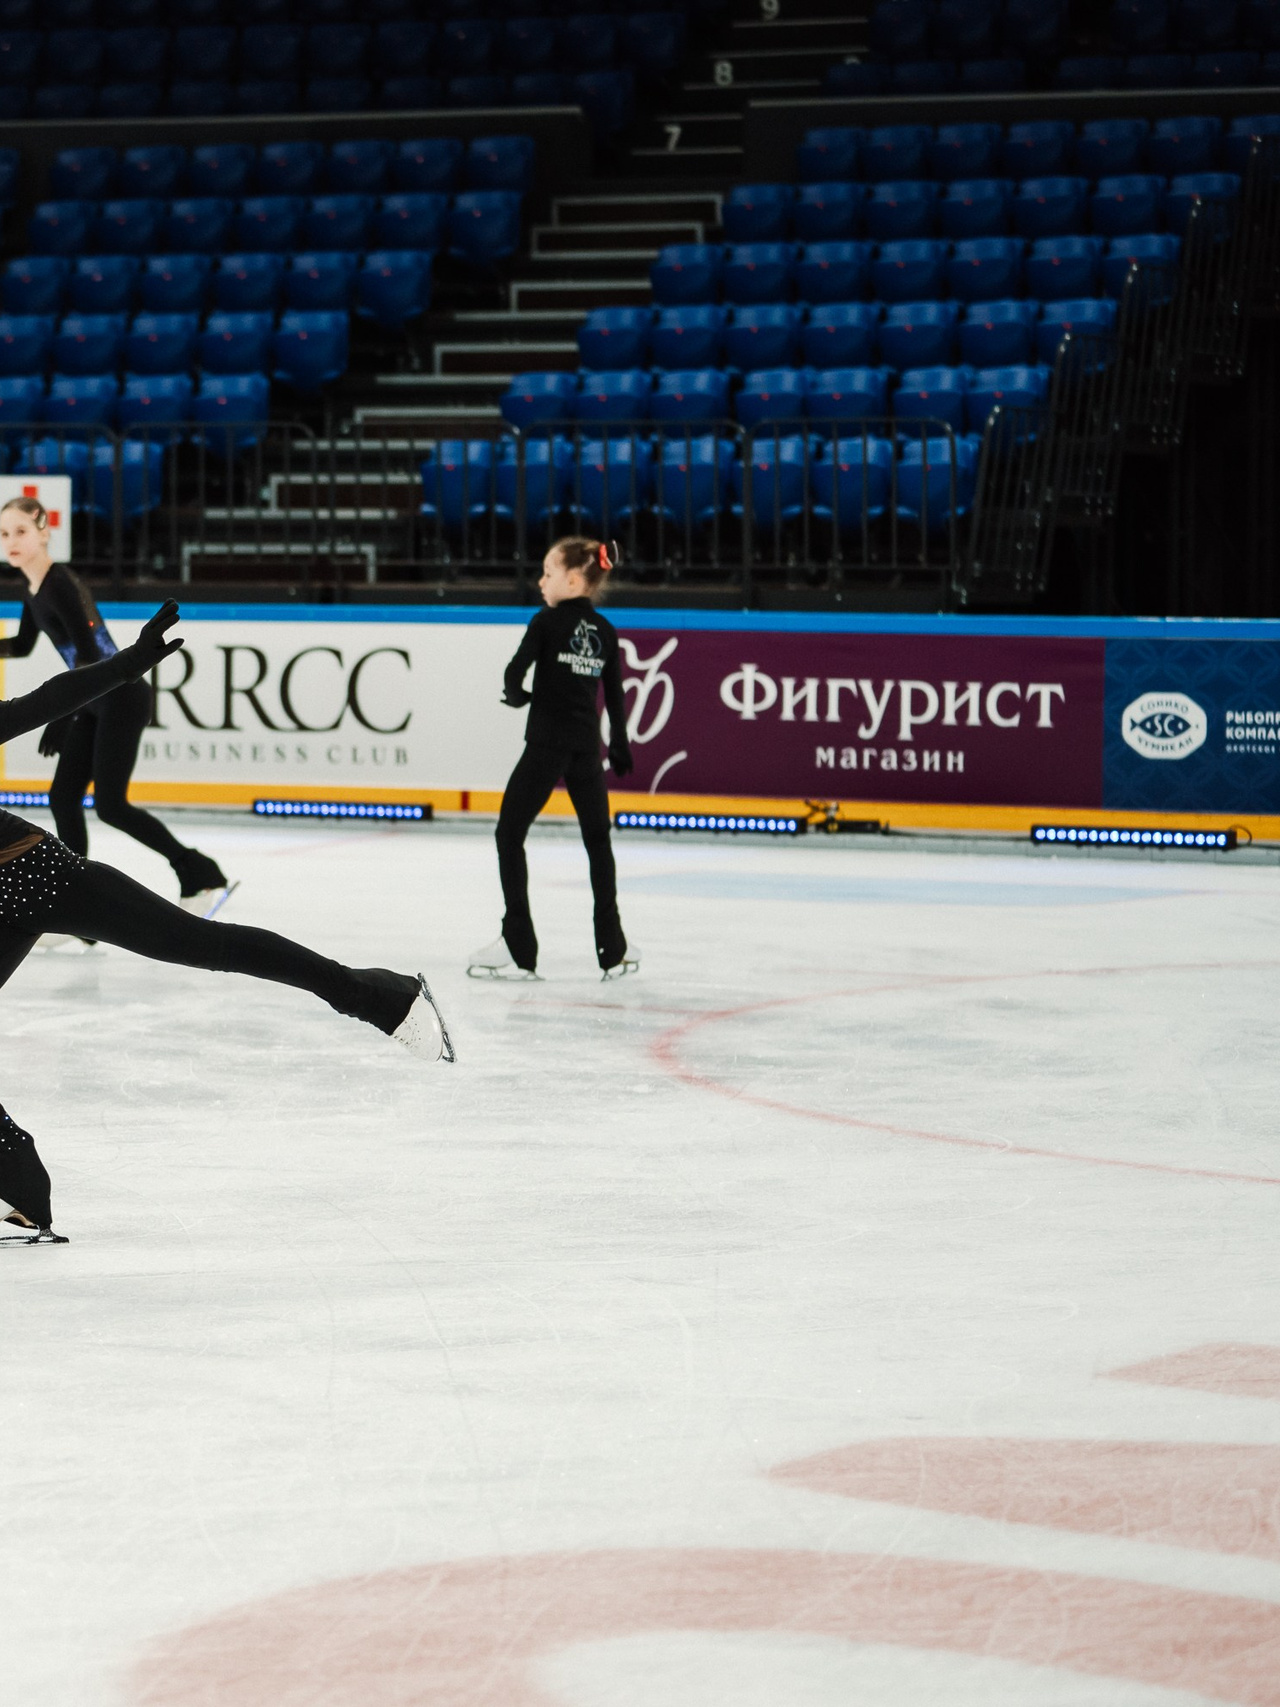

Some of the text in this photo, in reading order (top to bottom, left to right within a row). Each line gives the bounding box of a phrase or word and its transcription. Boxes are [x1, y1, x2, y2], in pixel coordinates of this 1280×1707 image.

[761, 0, 779, 20] 9
[714, 60, 733, 86] 8
[664, 124, 682, 150] 7
[144, 645, 413, 735] RRCC
[719, 662, 1066, 741] Фигурист
[143, 741, 411, 767] BUSINESS CLUB
[815, 746, 966, 773] магазин
